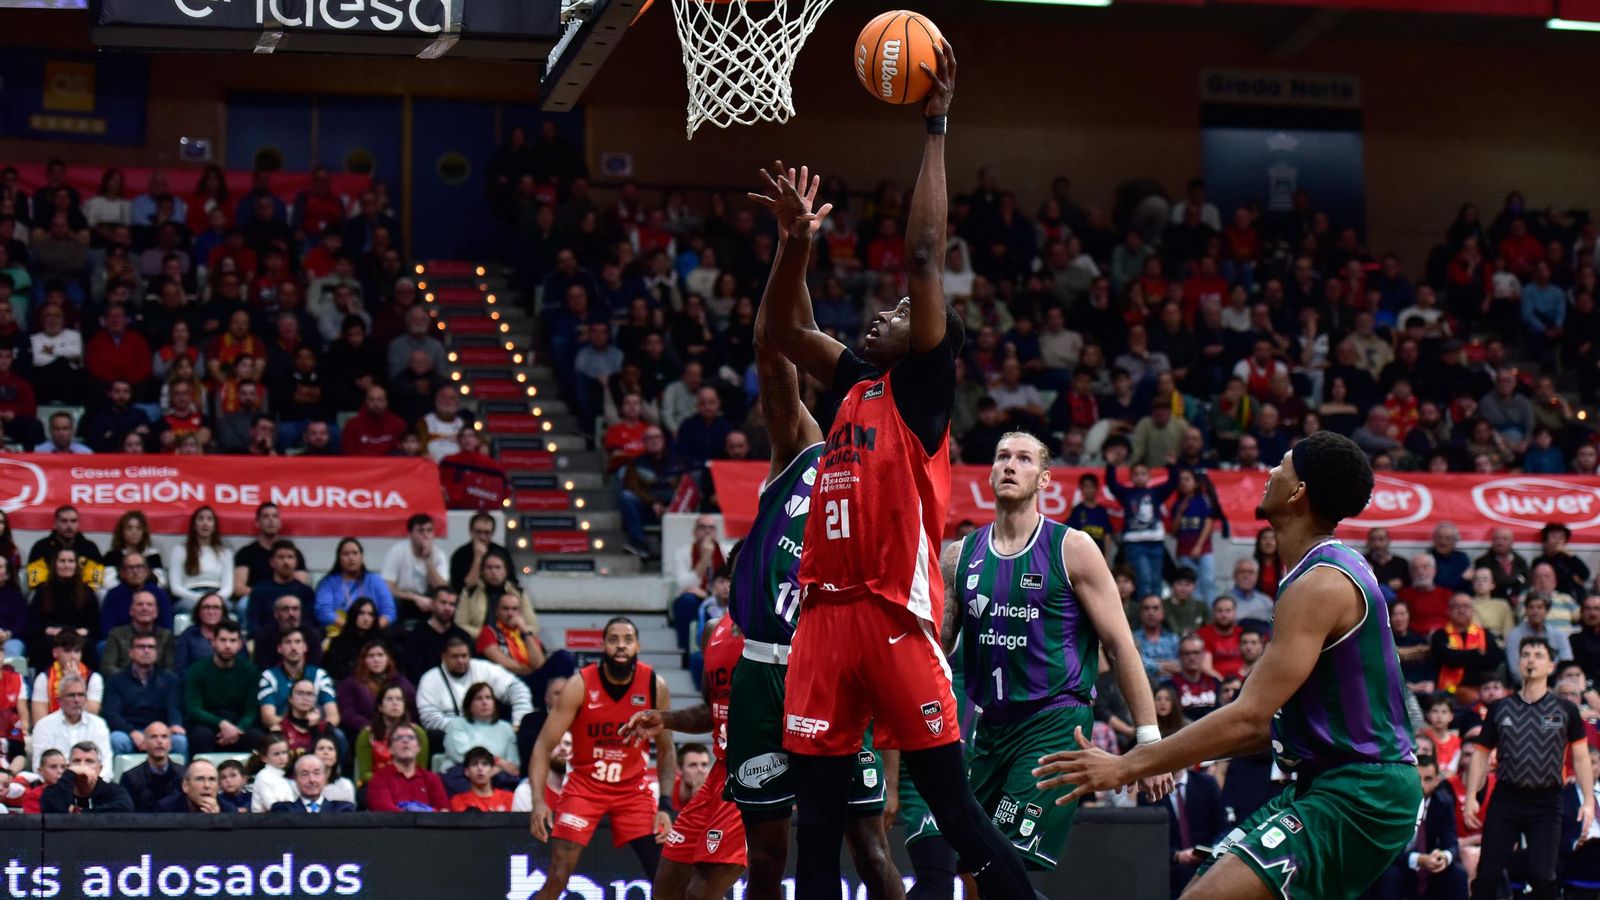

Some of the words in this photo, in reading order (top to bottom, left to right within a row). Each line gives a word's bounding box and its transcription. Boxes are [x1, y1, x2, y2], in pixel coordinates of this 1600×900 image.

[882, 39, 901, 97] Wilson
[71, 467, 121, 479] Costa
[125, 466, 179, 478] Cálida
[71, 478, 206, 504] REGIÓN
[215, 484, 261, 506] DE
[270, 485, 408, 510] MURCIA
[1494, 491, 1593, 514] Juver
[825, 498, 850, 540] 21
[775, 581, 800, 622] 11
[992, 667, 1003, 700] 1
[924, 705, 938, 715] acb
[587, 721, 632, 738] UCA
[591, 760, 622, 784] 30
[741, 756, 787, 782] famades
[860, 755, 873, 763] acb
[4, 858, 61, 898] ts
[82, 853, 362, 898] adosados
